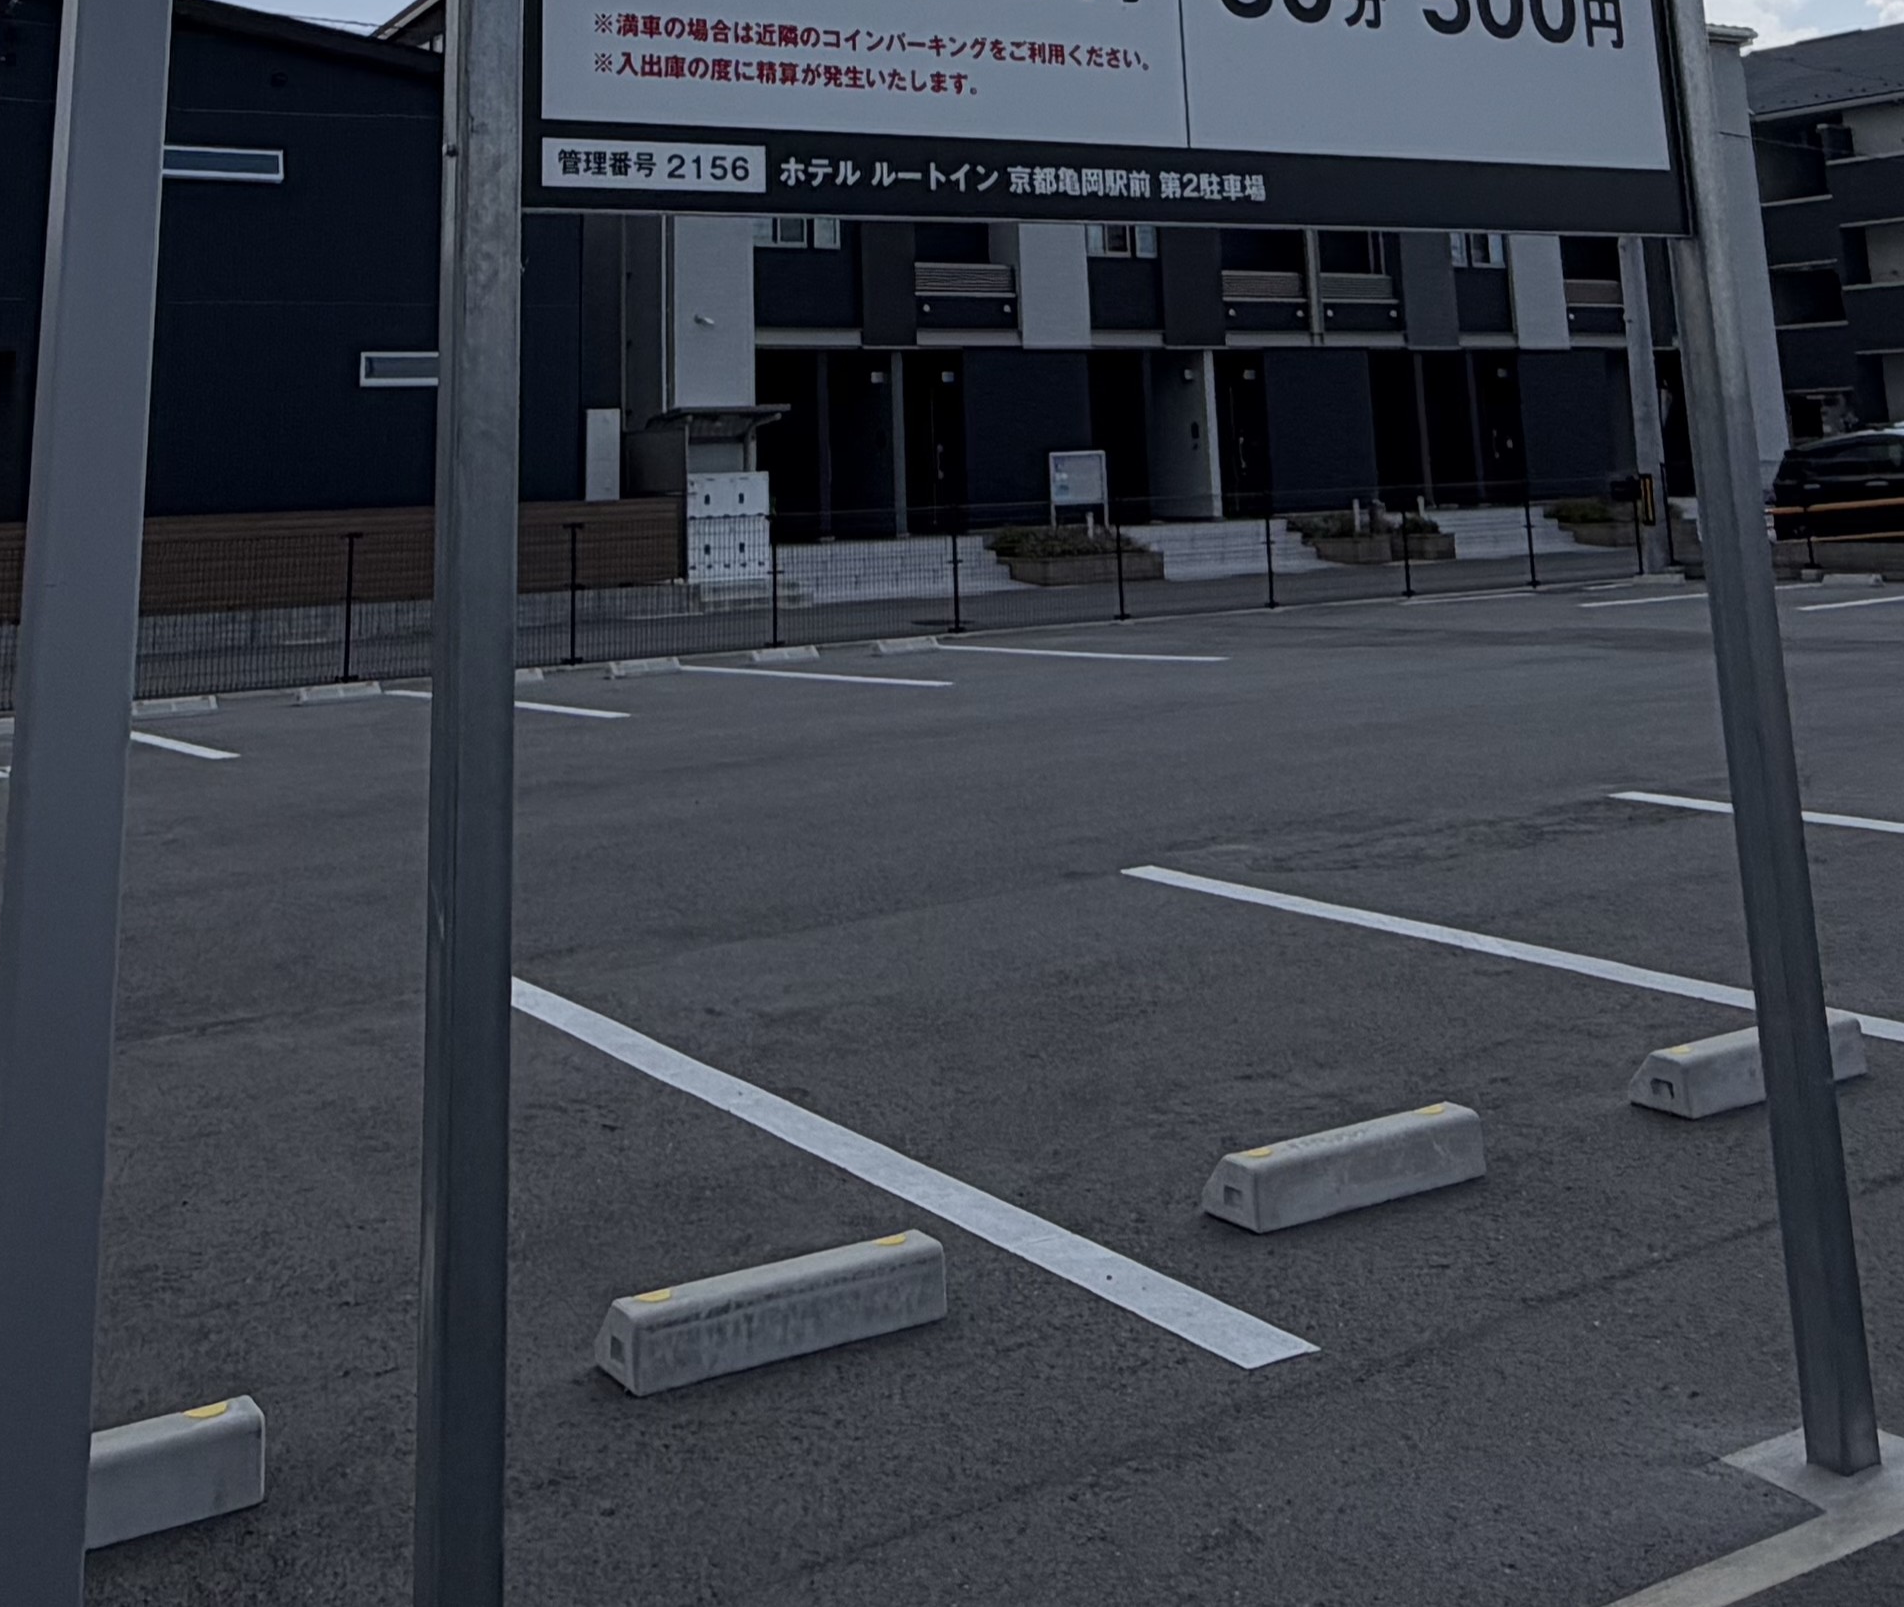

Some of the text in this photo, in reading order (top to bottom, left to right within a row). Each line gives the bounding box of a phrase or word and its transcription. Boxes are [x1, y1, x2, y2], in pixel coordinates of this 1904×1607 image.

[595, 52, 977, 94] ※入出庫の度に精算が発生いたします。
[558, 149, 749, 181] 管理番号 2156
[780, 157, 1265, 201] ホテル ルートイン 京都亀岡駅前 第2駐車場
